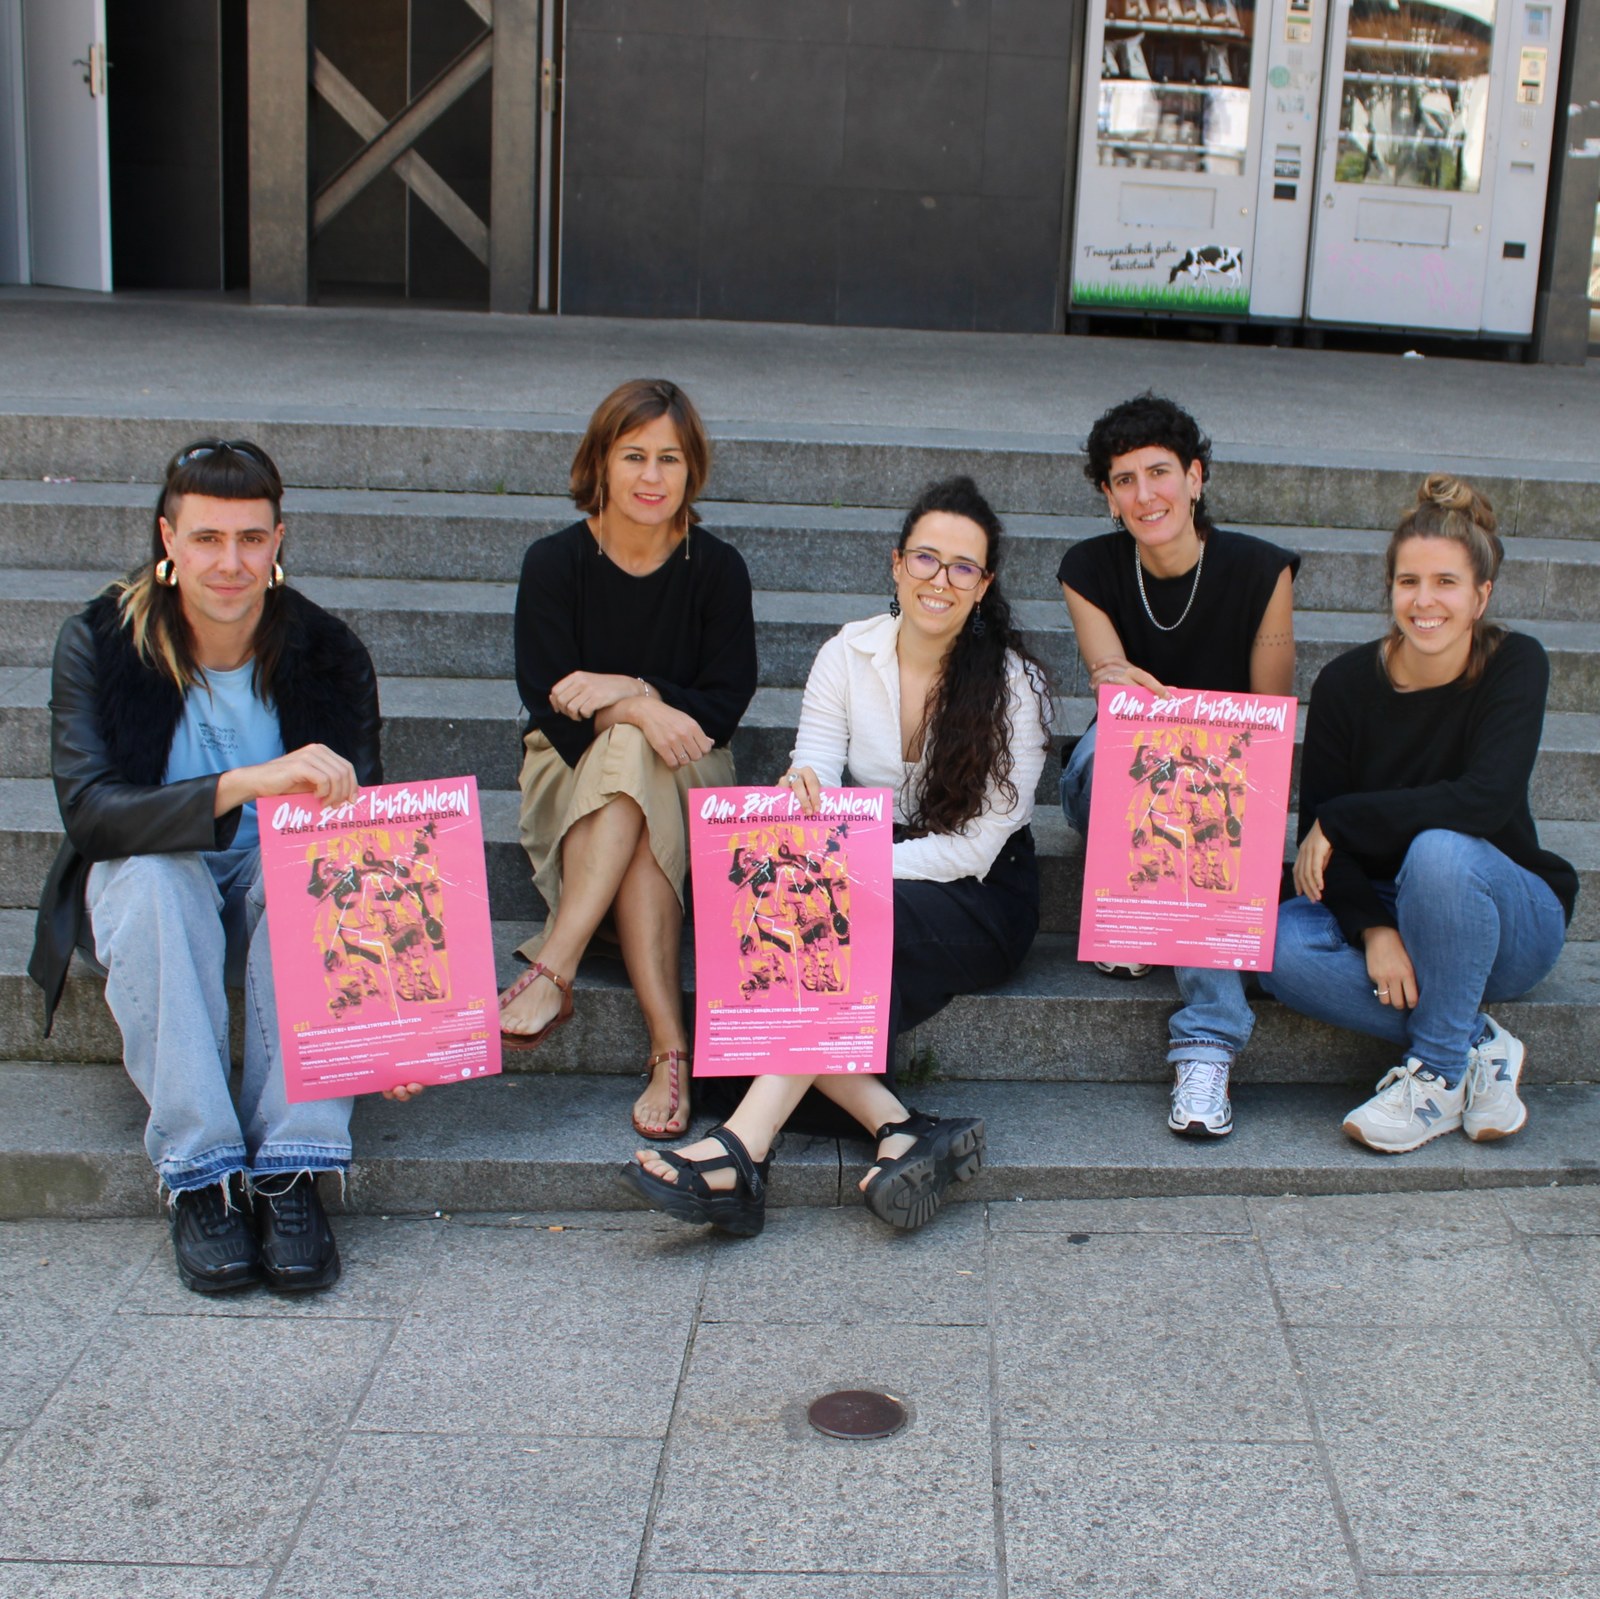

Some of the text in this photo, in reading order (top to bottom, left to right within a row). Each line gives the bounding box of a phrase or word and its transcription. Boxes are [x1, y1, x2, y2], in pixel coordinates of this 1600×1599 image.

[1115, 713, 1145, 722] ZAURI
[1147, 714, 1165, 723] ETA
[1167, 717, 1207, 726] ARDURA
[280, 810, 462, 836] ZAURI ETA ARDURA KOLEKTIBOAK
[707, 813, 875, 825] ZAURI ETA ARDURA KOLEKTIBOAK
